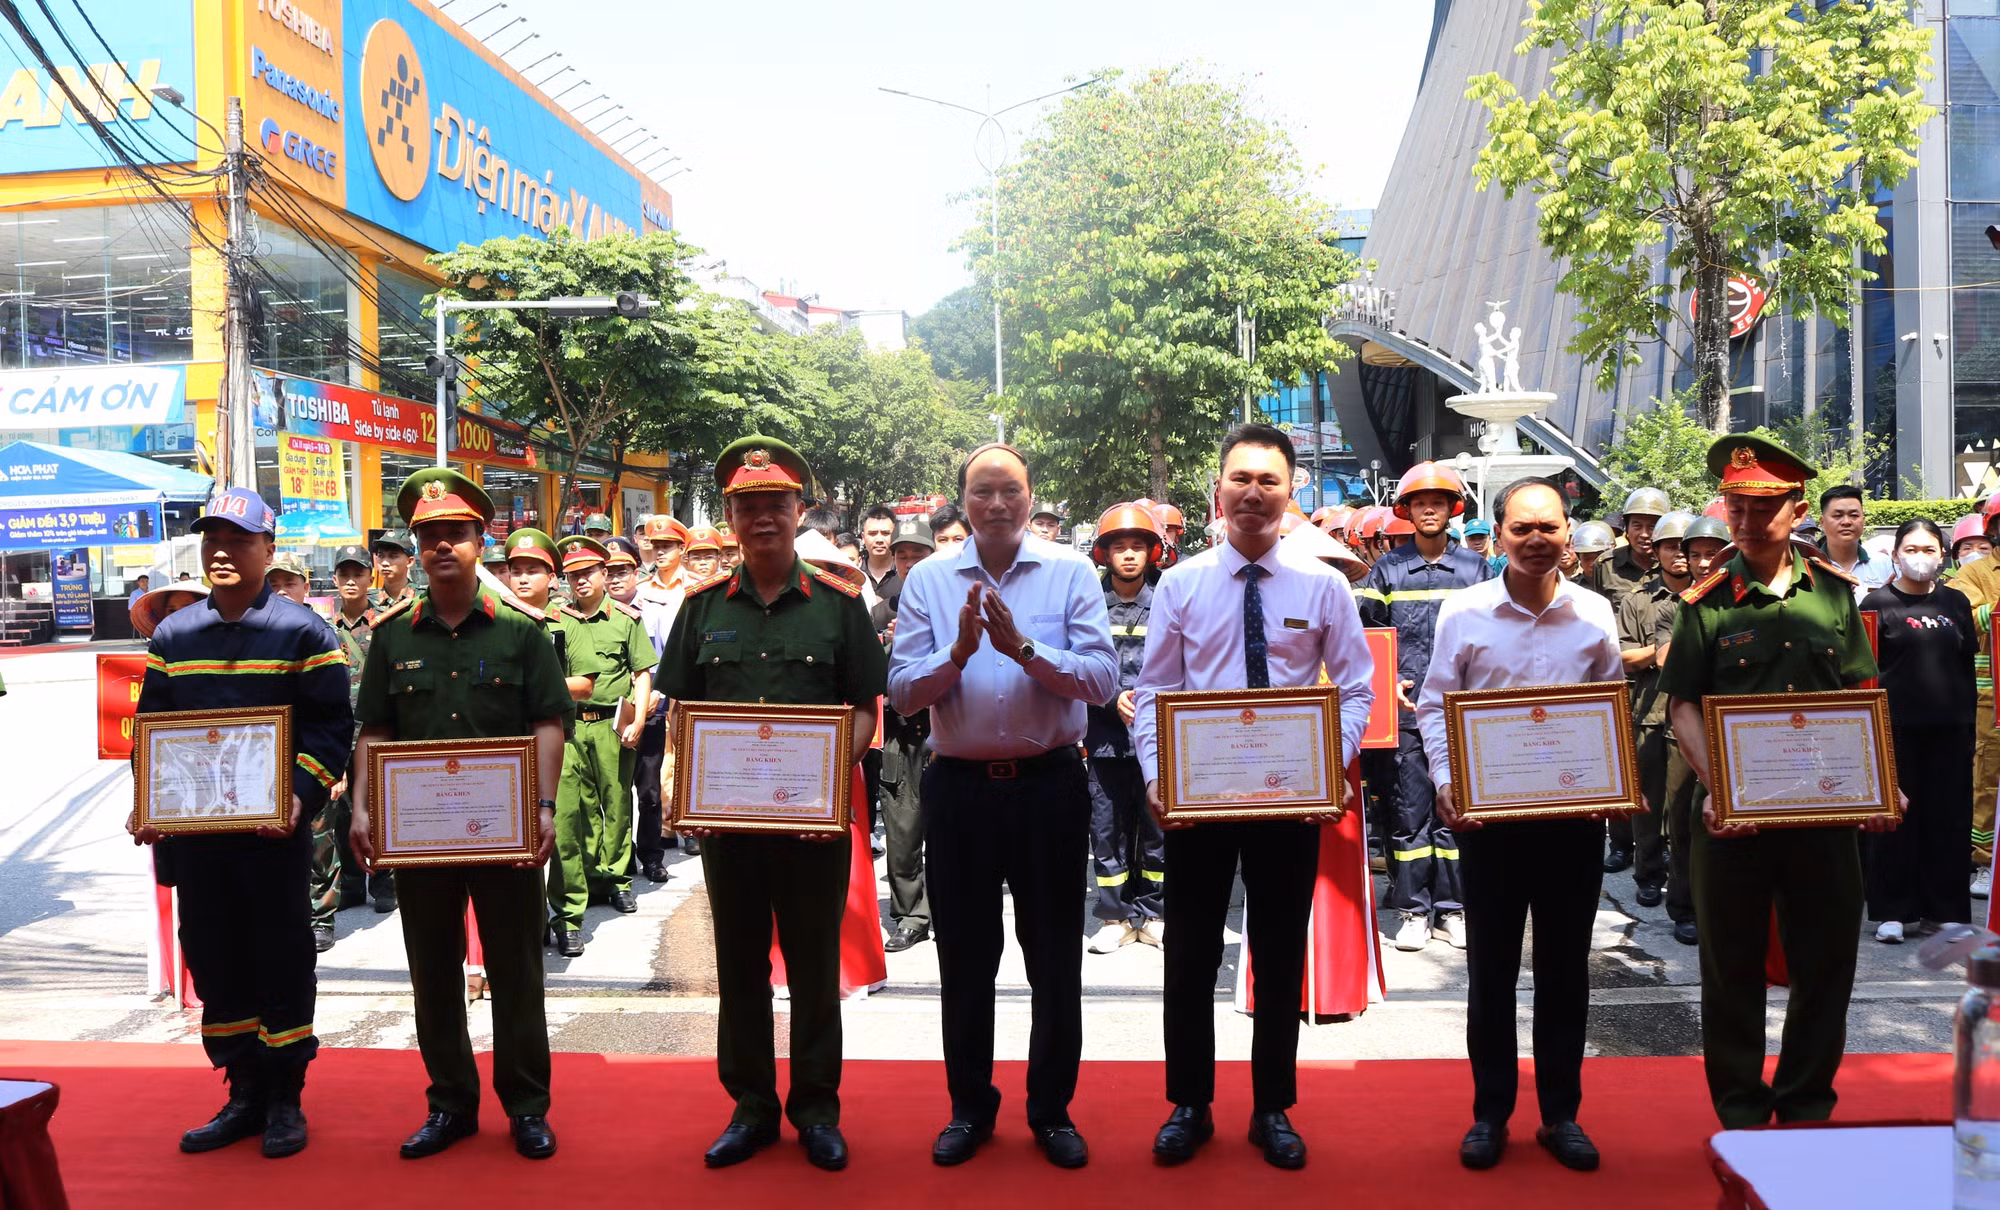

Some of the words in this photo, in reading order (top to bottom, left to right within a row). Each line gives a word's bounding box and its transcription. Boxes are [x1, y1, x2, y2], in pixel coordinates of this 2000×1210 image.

[252, 44, 340, 123] Panasonic
[283, 130, 337, 178] GREE
[434, 102, 509, 215] Điện
[67, 340, 89, 352] Hisense
[9, 375, 94, 415] CẢM
[101, 379, 160, 411] ƠN
[371, 397, 383, 417] Tủ
[382, 401, 400, 421] lạnh
[287, 393, 351, 427] TOSHIBA
[354, 419, 372, 438] Side
[373, 421, 385, 442] by
[385, 424, 401, 441] side
[8, 515, 36, 529] GIẢM
[37, 513, 58, 528] ĐẾN
[58, 512, 77, 528] 3,9
[78, 511, 106, 527] TRIỆU
[210, 494, 249, 518] 114
